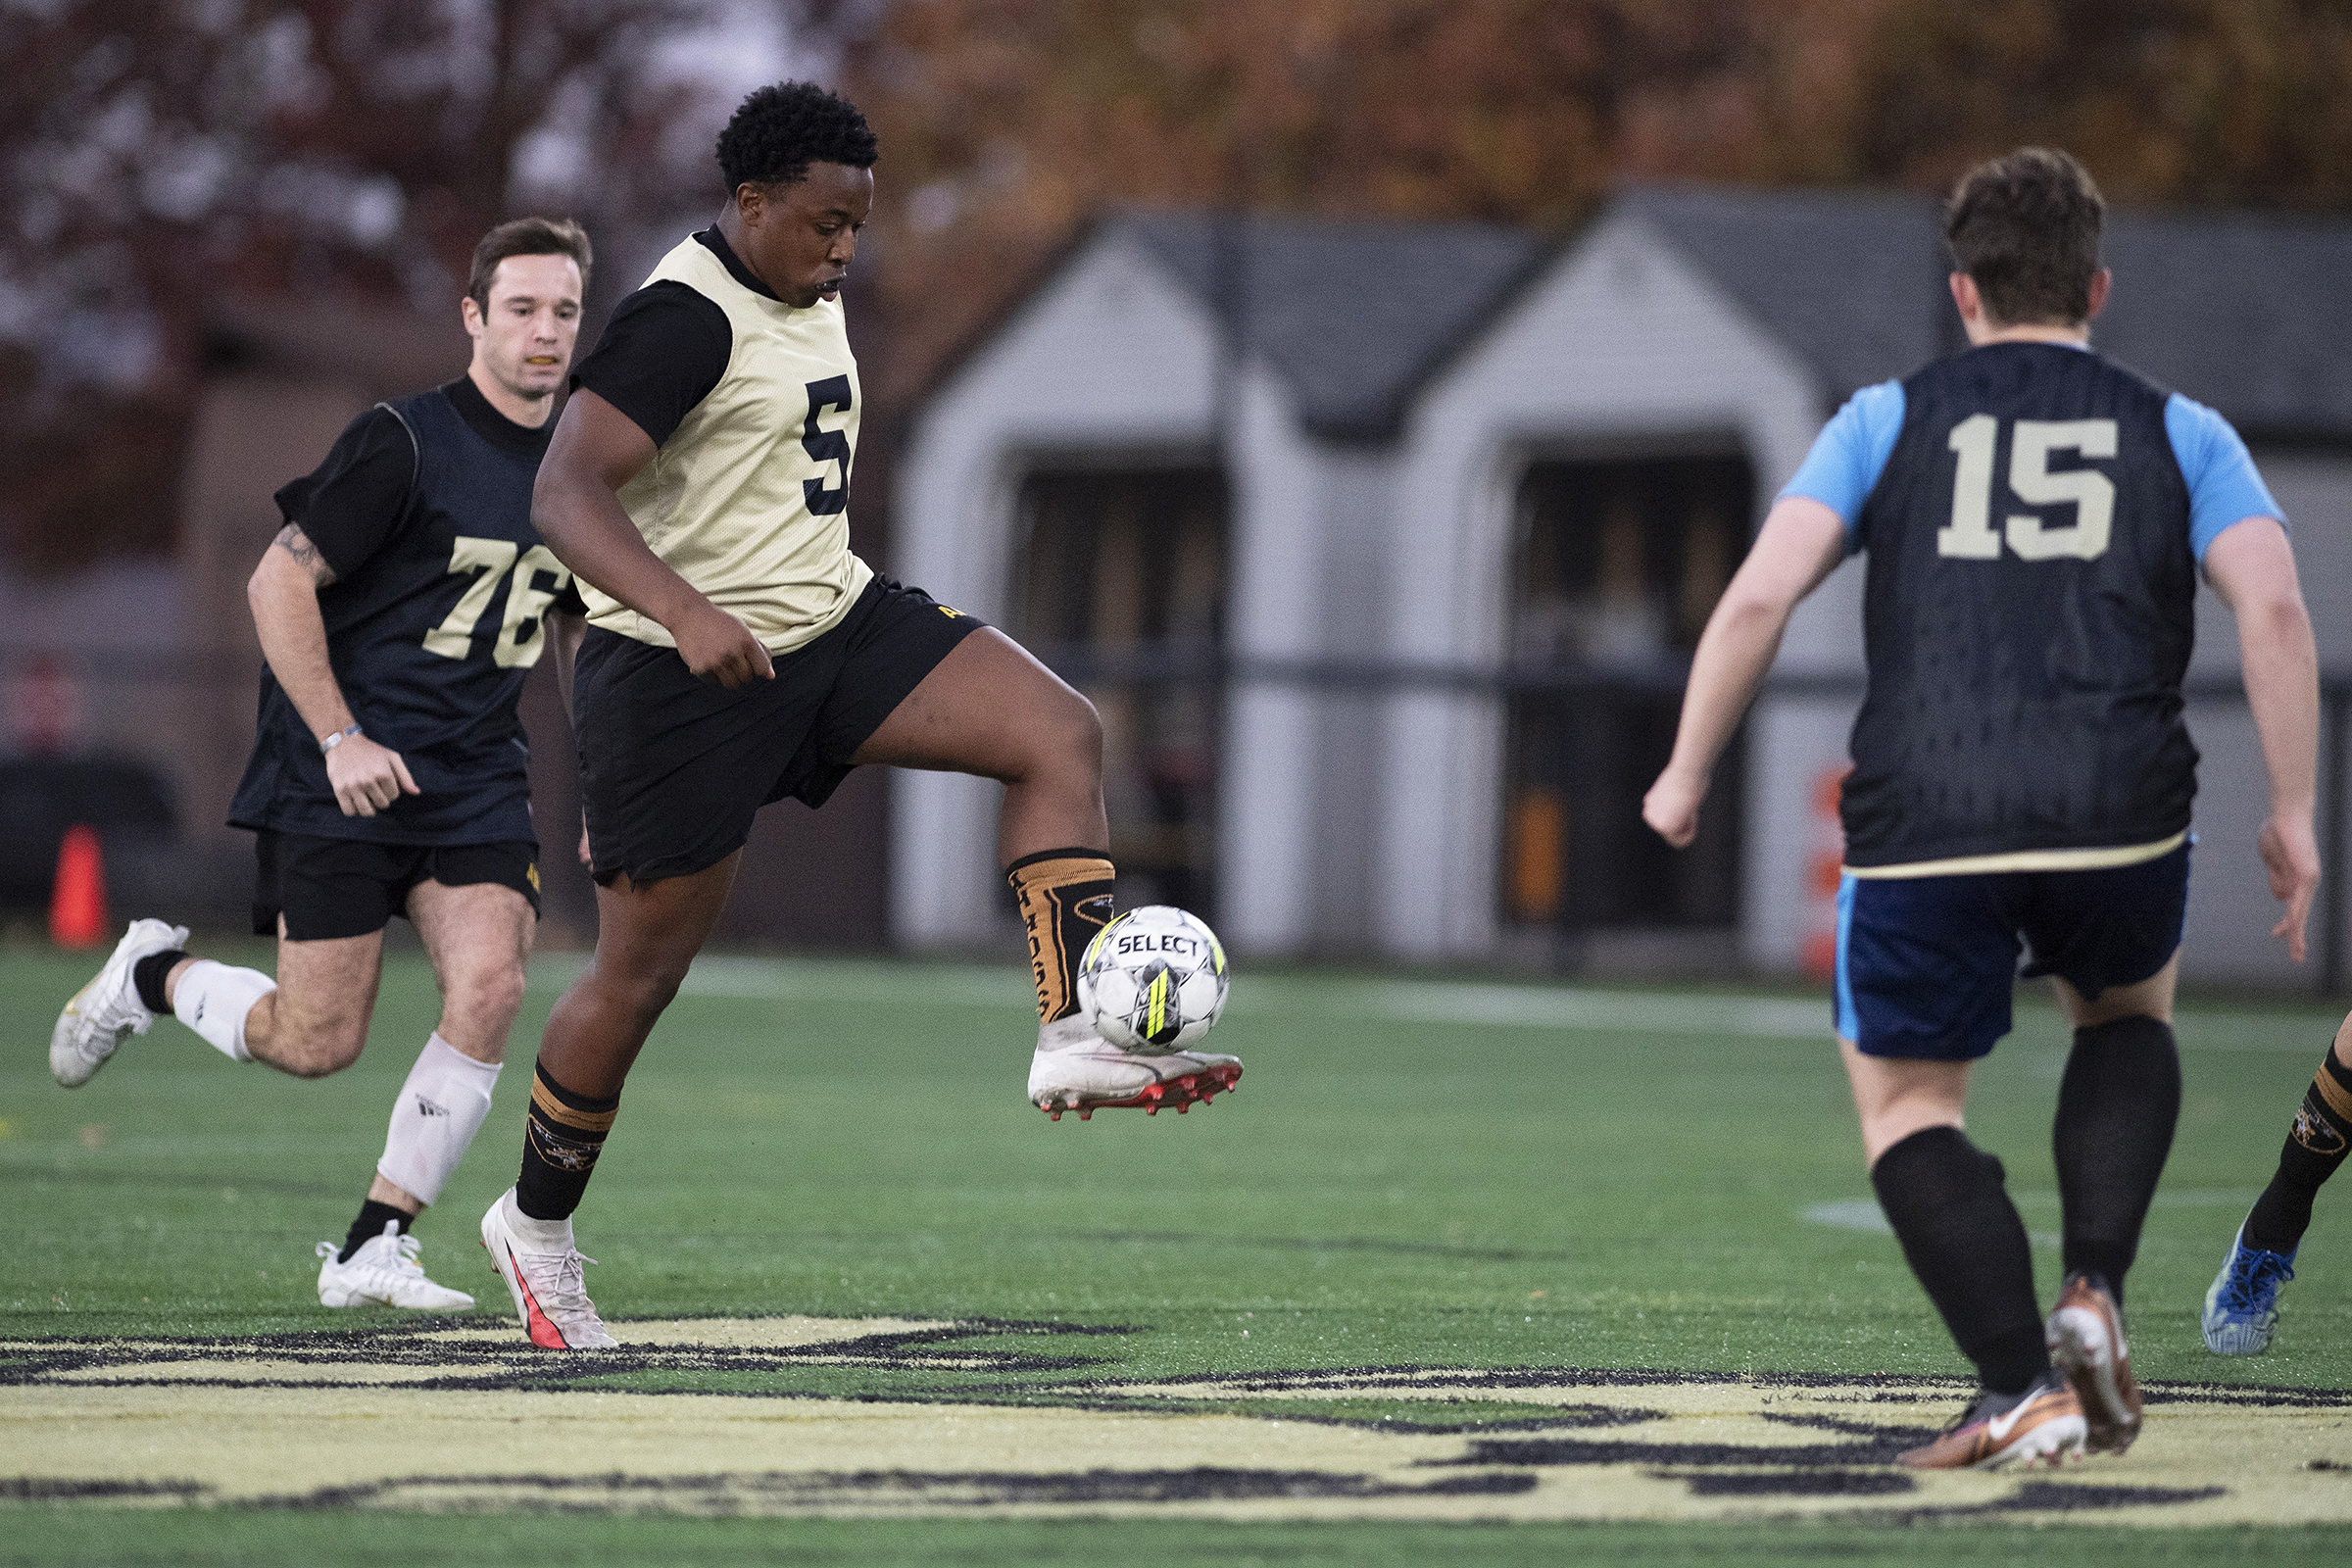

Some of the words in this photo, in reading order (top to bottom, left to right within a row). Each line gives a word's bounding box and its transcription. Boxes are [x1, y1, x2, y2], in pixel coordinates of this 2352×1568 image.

[802, 373, 852, 515] 5
[1937, 413, 2118, 562] 15
[421, 536, 572, 667] 76
[1118, 934, 1197, 956] SELECT
